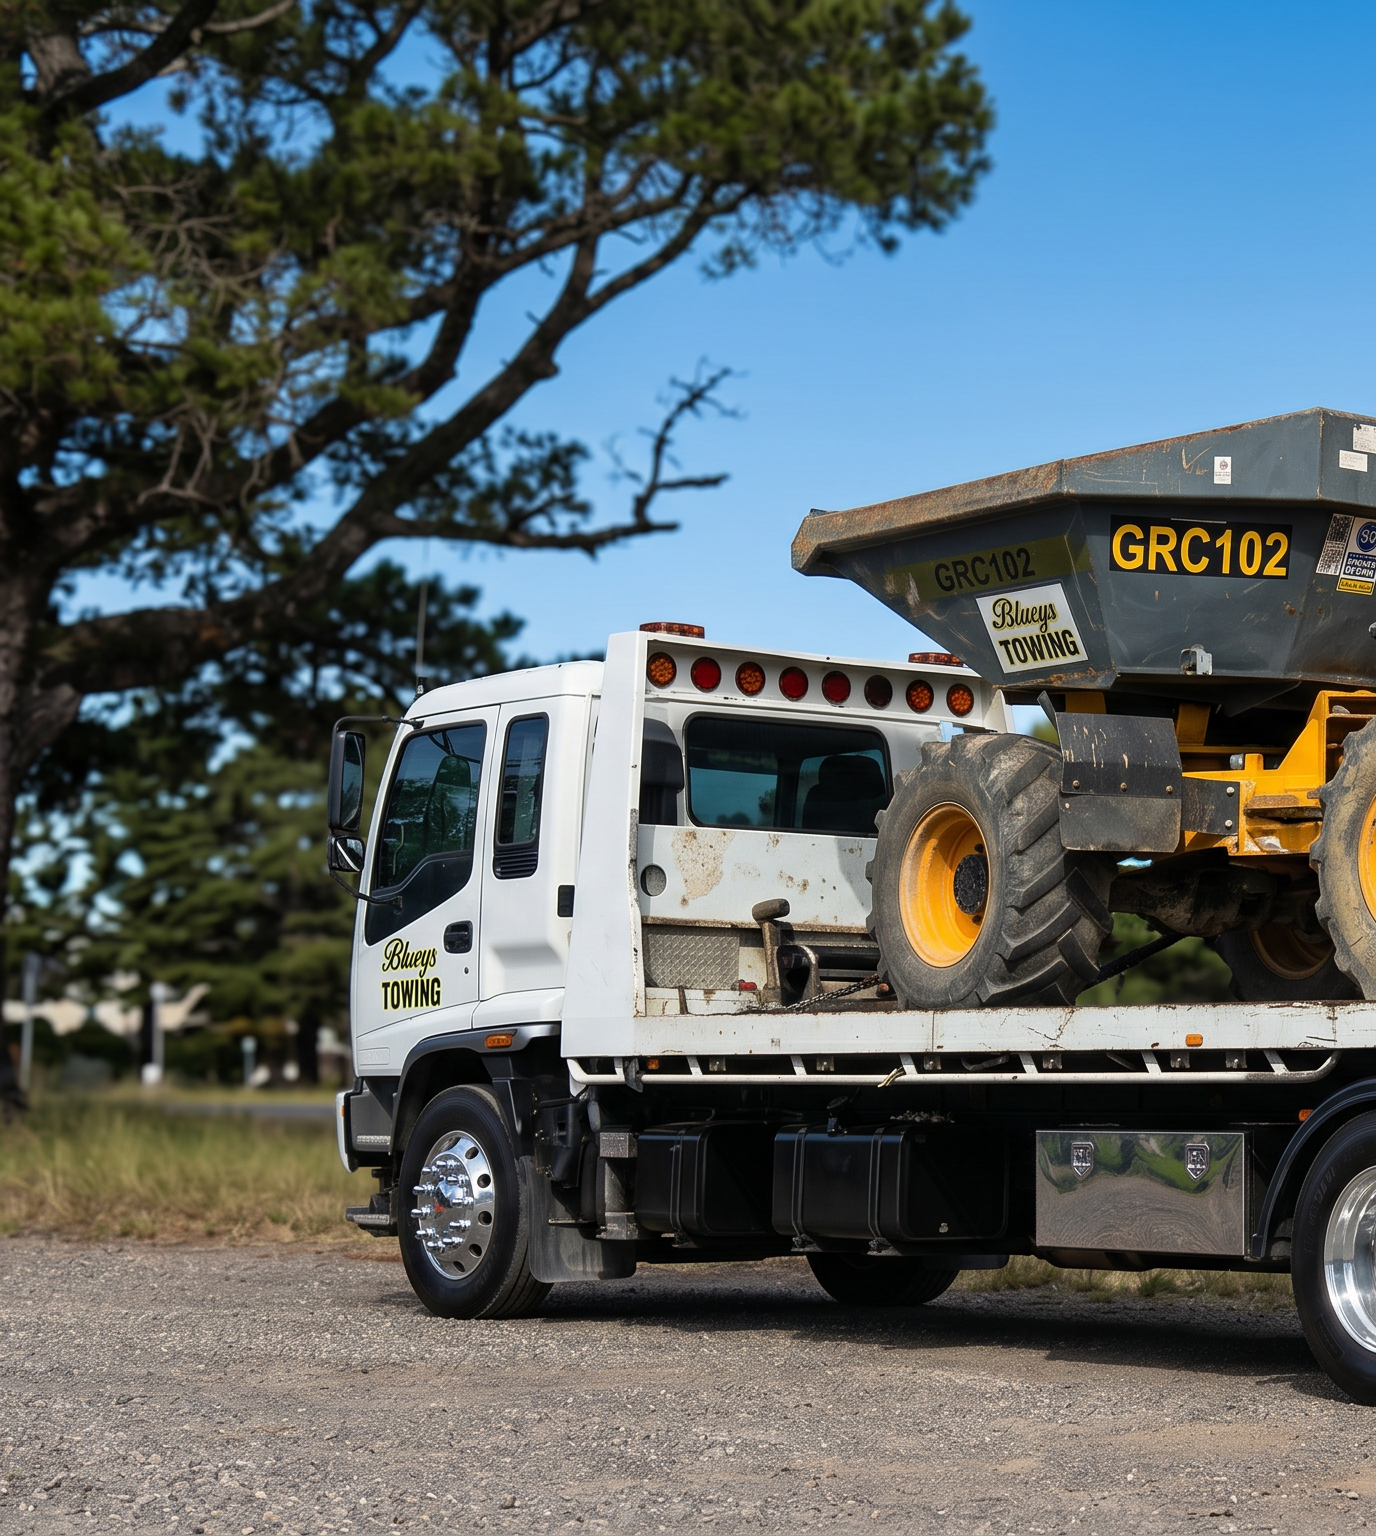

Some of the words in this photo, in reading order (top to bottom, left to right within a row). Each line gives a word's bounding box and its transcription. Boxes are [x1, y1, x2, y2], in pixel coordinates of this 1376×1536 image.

[934, 547, 1036, 592] GRC102
[1112, 523, 1290, 577] GRC102
[991, 598, 1058, 633] Blueys
[998, 628, 1081, 666] TOWING
[382, 937, 438, 979] Blueys
[381, 976, 441, 1011] TOWING
